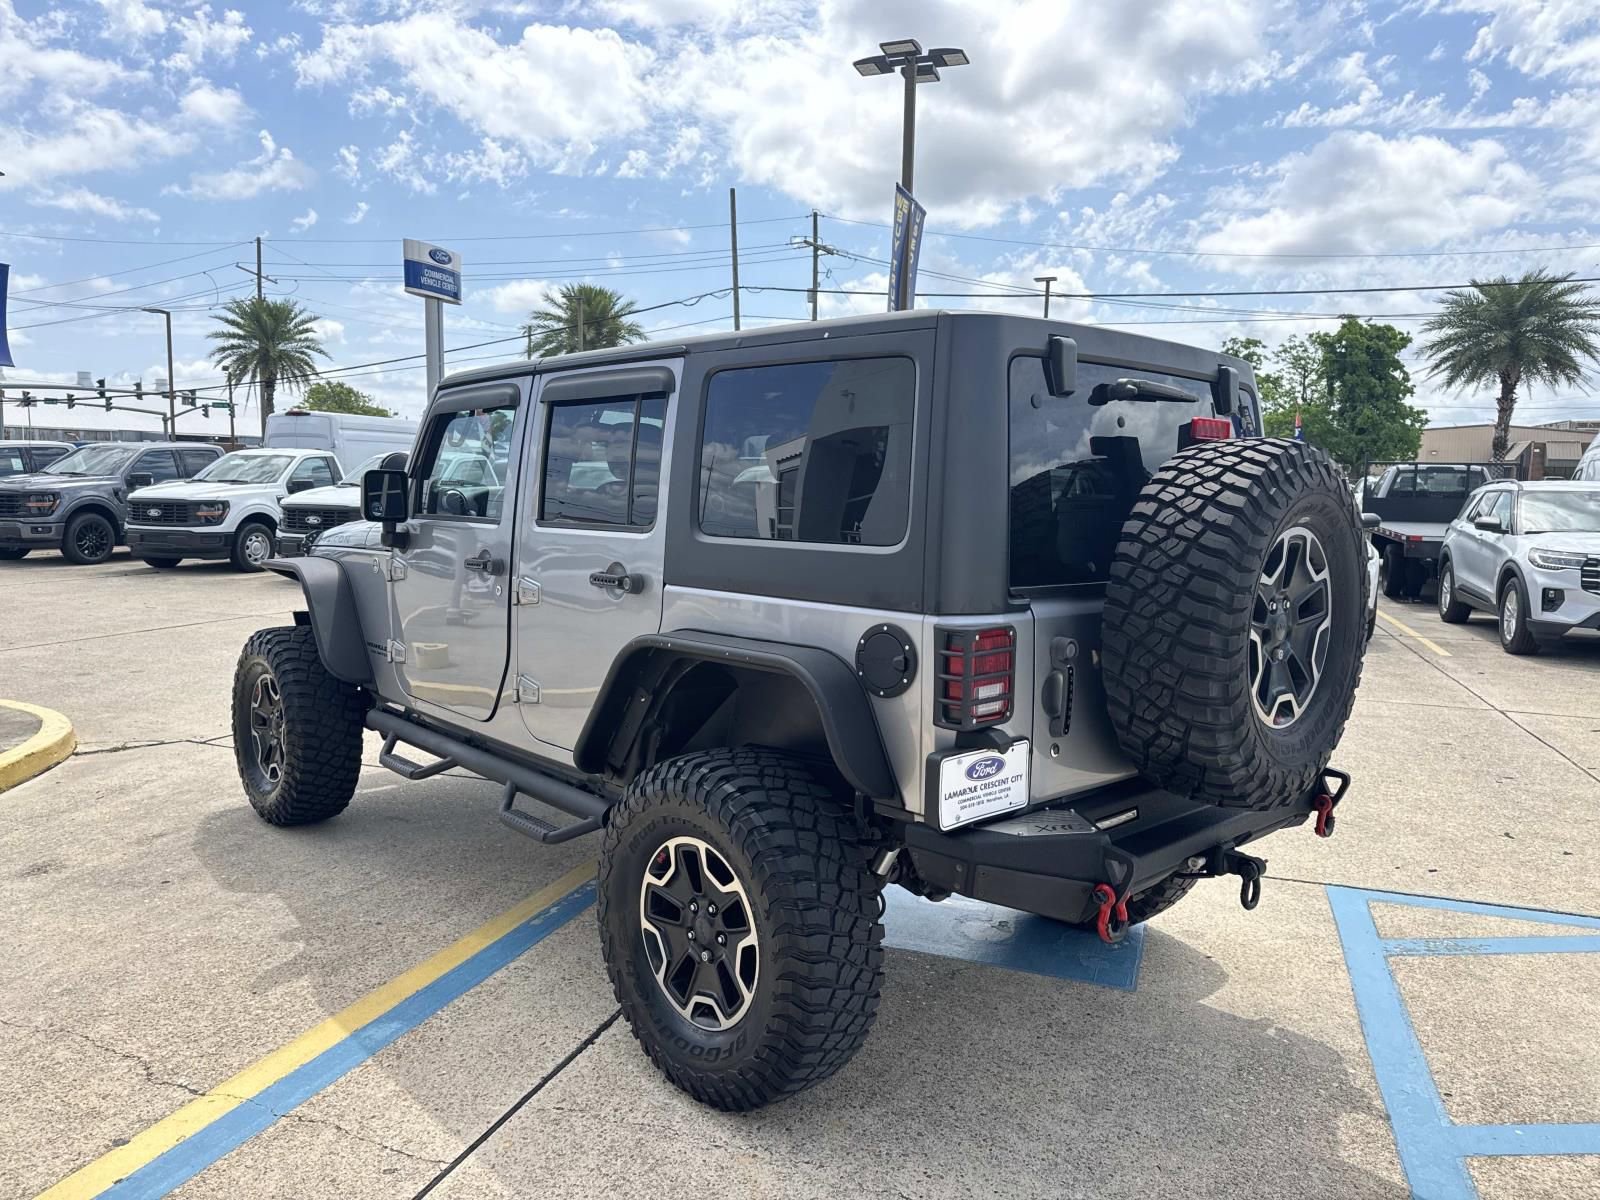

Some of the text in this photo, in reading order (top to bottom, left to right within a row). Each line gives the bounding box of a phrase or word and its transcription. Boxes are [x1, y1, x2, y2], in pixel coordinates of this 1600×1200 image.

[420, 276, 457, 292] VEHICLE CENTER
[424, 269, 454, 284] COMMERCIAL
[972, 760, 998, 778] Ford
[944, 773, 1023, 801] LAMARQUE CRESCENT CITY
[957, 786, 1011, 805] COMMERCIAL VEHICLE CENTER
